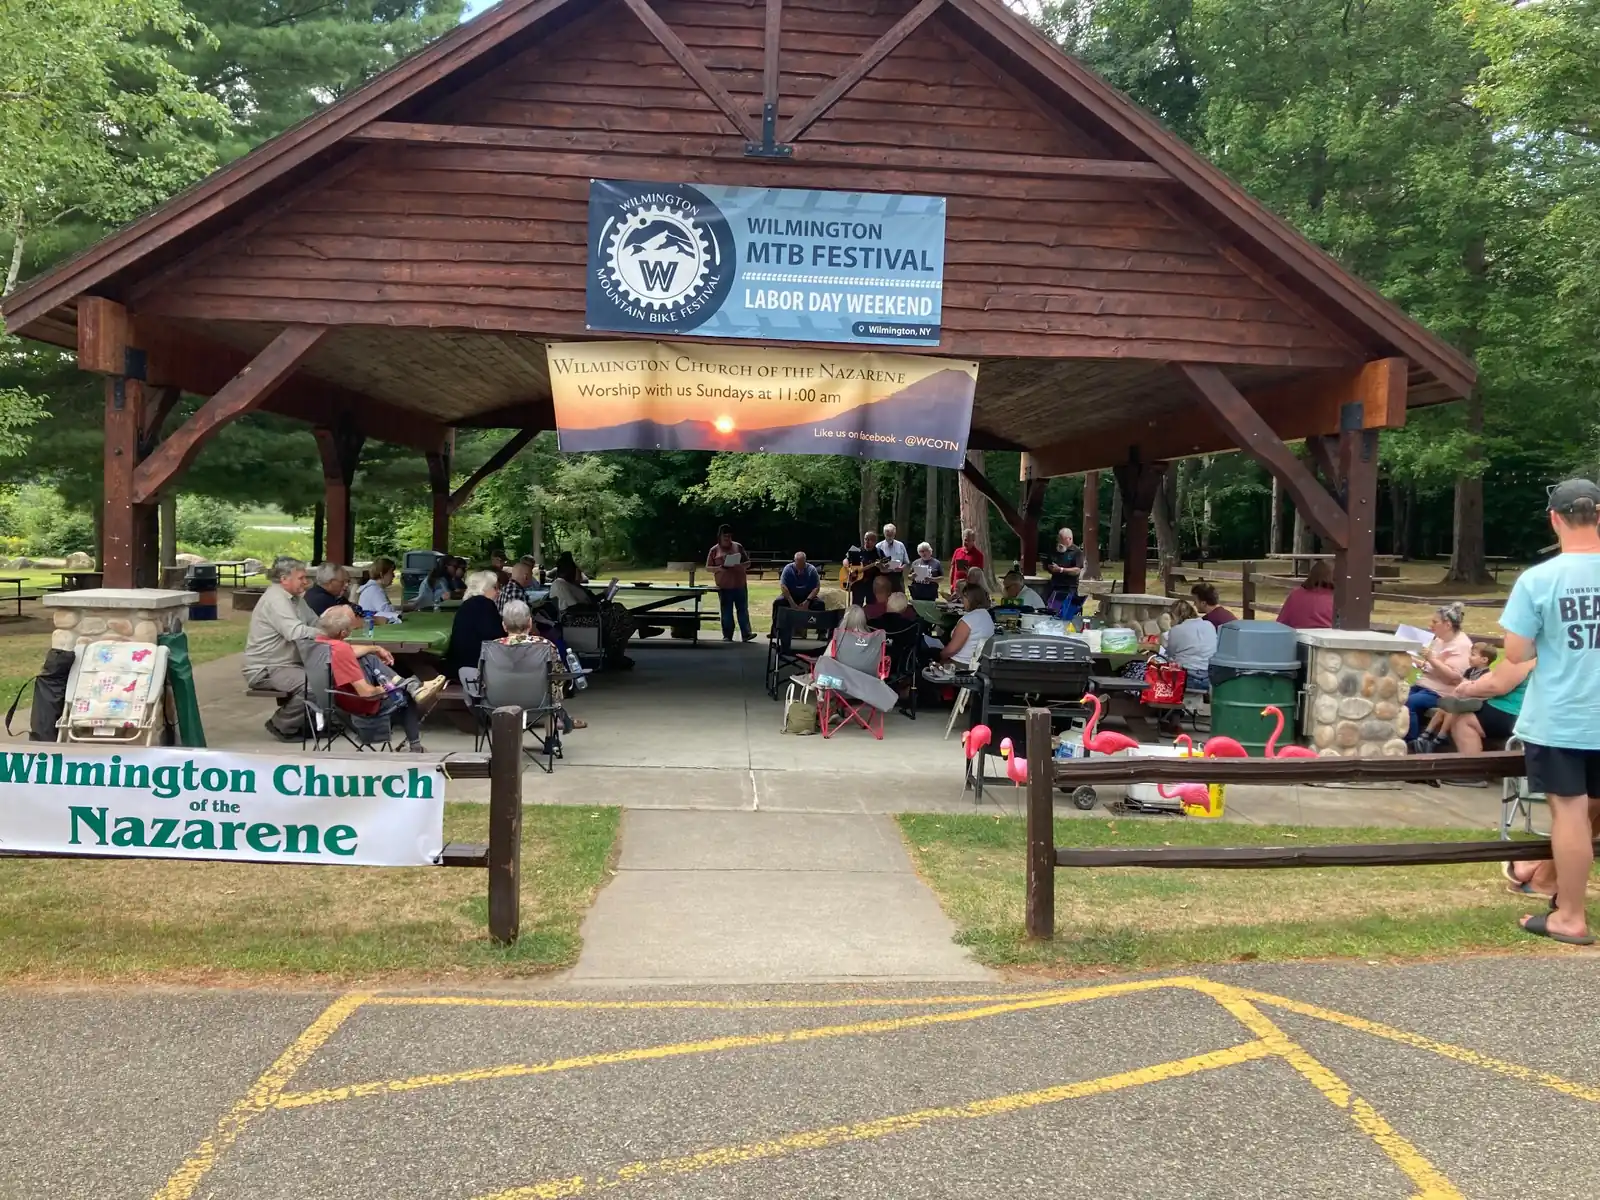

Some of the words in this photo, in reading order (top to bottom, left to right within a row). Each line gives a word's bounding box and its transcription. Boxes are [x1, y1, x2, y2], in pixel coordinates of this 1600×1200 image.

[619, 193, 700, 216] WILMINGTON
[747, 217, 883, 240] WILMINGTON
[746, 241, 804, 266] MTB
[812, 245, 934, 272] FESTIVAL
[638, 259, 679, 293] W
[596, 267, 646, 321] MOUNTAIN
[649, 311, 678, 323] BIKE
[680, 273, 721, 318] FESTIVAL
[744, 288, 804, 311] LABOR
[808, 291, 844, 313] DAY
[846, 293, 933, 317] WEEKEND
[868, 325, 918, 337] Wilmington,
[919, 327, 932, 336] NY
[553, 358, 671, 375] WILMINGTON
[675, 356, 752, 377] CHURCH
[757, 365, 779, 378] OF
[782, 366, 814, 379] THE
[819, 363, 906, 384] NAZARENE
[578, 383, 641, 399] Worship
[644, 383, 673, 397] with
[676, 386, 692, 397] us
[696, 383, 754, 402] Sundays
[758, 389, 772, 400] at
[778, 387, 816, 402] 11:00
[820, 391, 841, 404] am
[814, 427, 834, 438] Like
[836, 430, 846, 438] us
[848, 431, 859, 439] on
[859, 430, 896, 444] facebook
[904, 435, 960, 451] @WCOTN
[0, 752, 257, 799] Wilmington
[272, 764, 435, 799] Church
[189, 798, 210, 813] of
[212, 798, 241, 814] the
[67, 805, 359, 856] Nazarene
